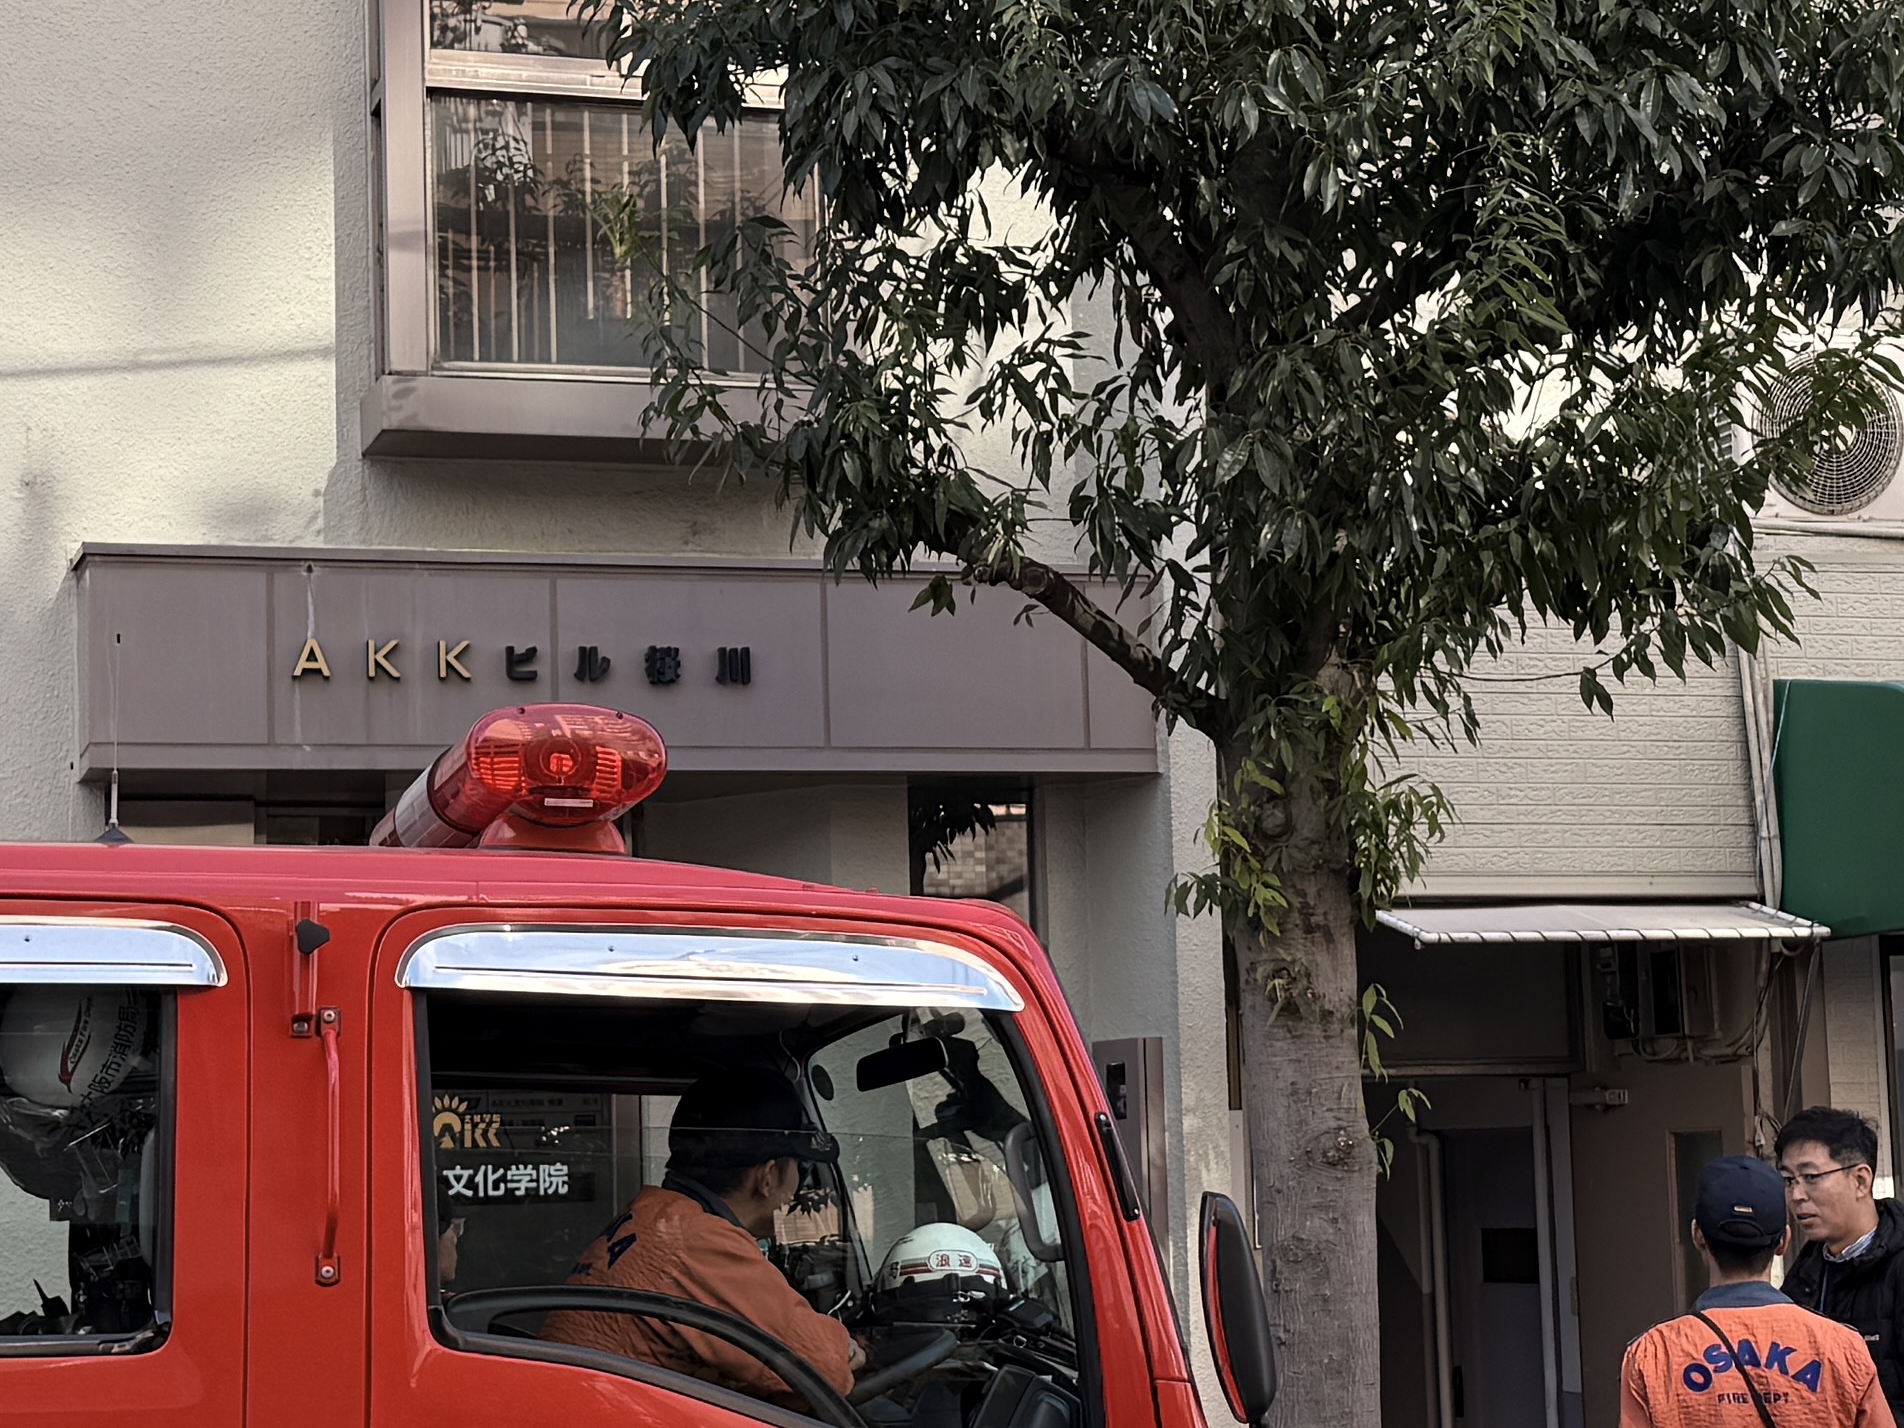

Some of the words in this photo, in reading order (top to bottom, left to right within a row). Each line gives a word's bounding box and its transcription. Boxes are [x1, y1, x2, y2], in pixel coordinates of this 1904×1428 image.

[442, 1162, 570, 1199] 文化学院
[1682, 1338, 1824, 1394] OSAKA
[1717, 1392, 1749, 1405] FIRE
